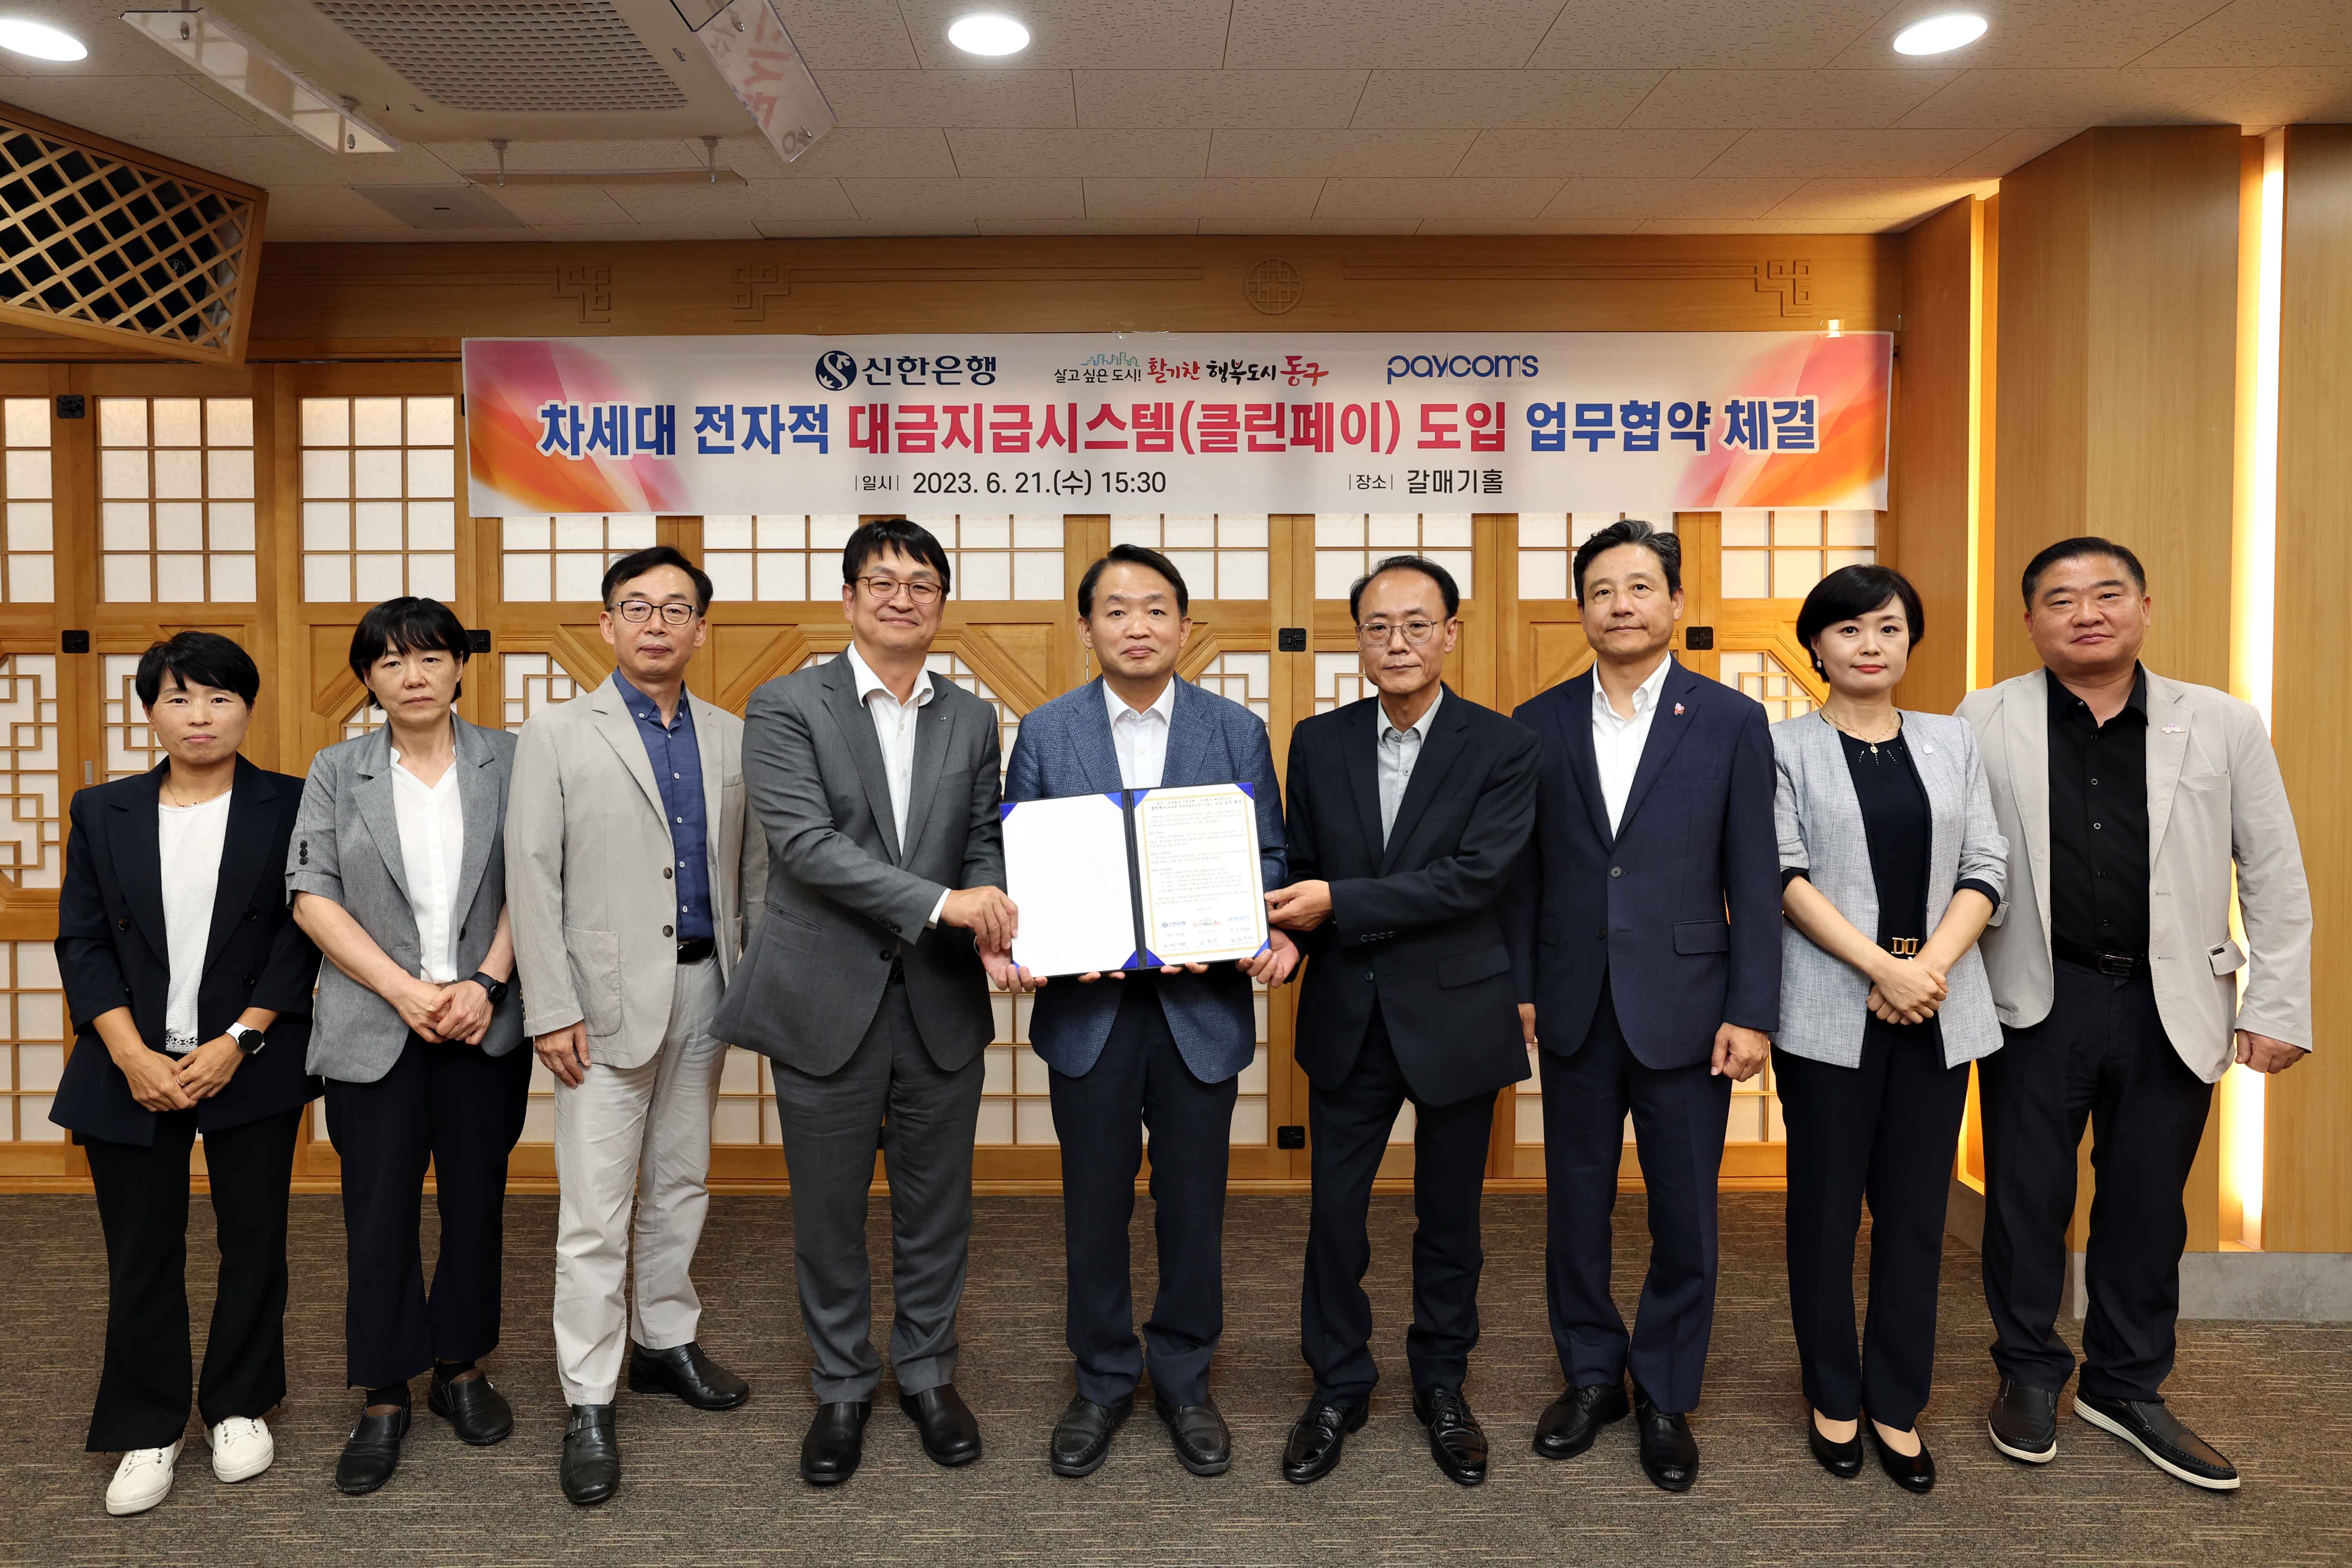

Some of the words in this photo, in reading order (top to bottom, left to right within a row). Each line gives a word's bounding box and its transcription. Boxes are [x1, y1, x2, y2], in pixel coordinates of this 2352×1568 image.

[862, 355, 996, 386] 신한은행
[1054, 368, 1080, 383] 살고
[1083, 368, 1107, 383] 싶은
[1111, 368, 1141, 383] 도시!
[1147, 357, 1201, 383] 활기찬
[1206, 359, 1276, 385] 행복도시
[1279, 356, 1329, 387] 동구
[1387, 354, 1539, 385] paycoms
[541, 404, 675, 456] 차세대
[693, 403, 828, 454] 전자적
[849, 400, 1401, 455] 대금지급시스템(클린페이)
[1417, 402, 1505, 452] 도입
[1526, 399, 1711, 452] 업무협약
[1724, 399, 1815, 450] 체결
[862, 475, 892, 491] 일시
[913, 472, 978, 494] 2023.
[986, 472, 1007, 494] 6.
[1015, 469, 1092, 496] 21.(수)
[1102, 472, 1166, 493] 15:30
[1356, 474, 1387, 490] 장소
[1407, 468, 1503, 494] 갈매기홀
